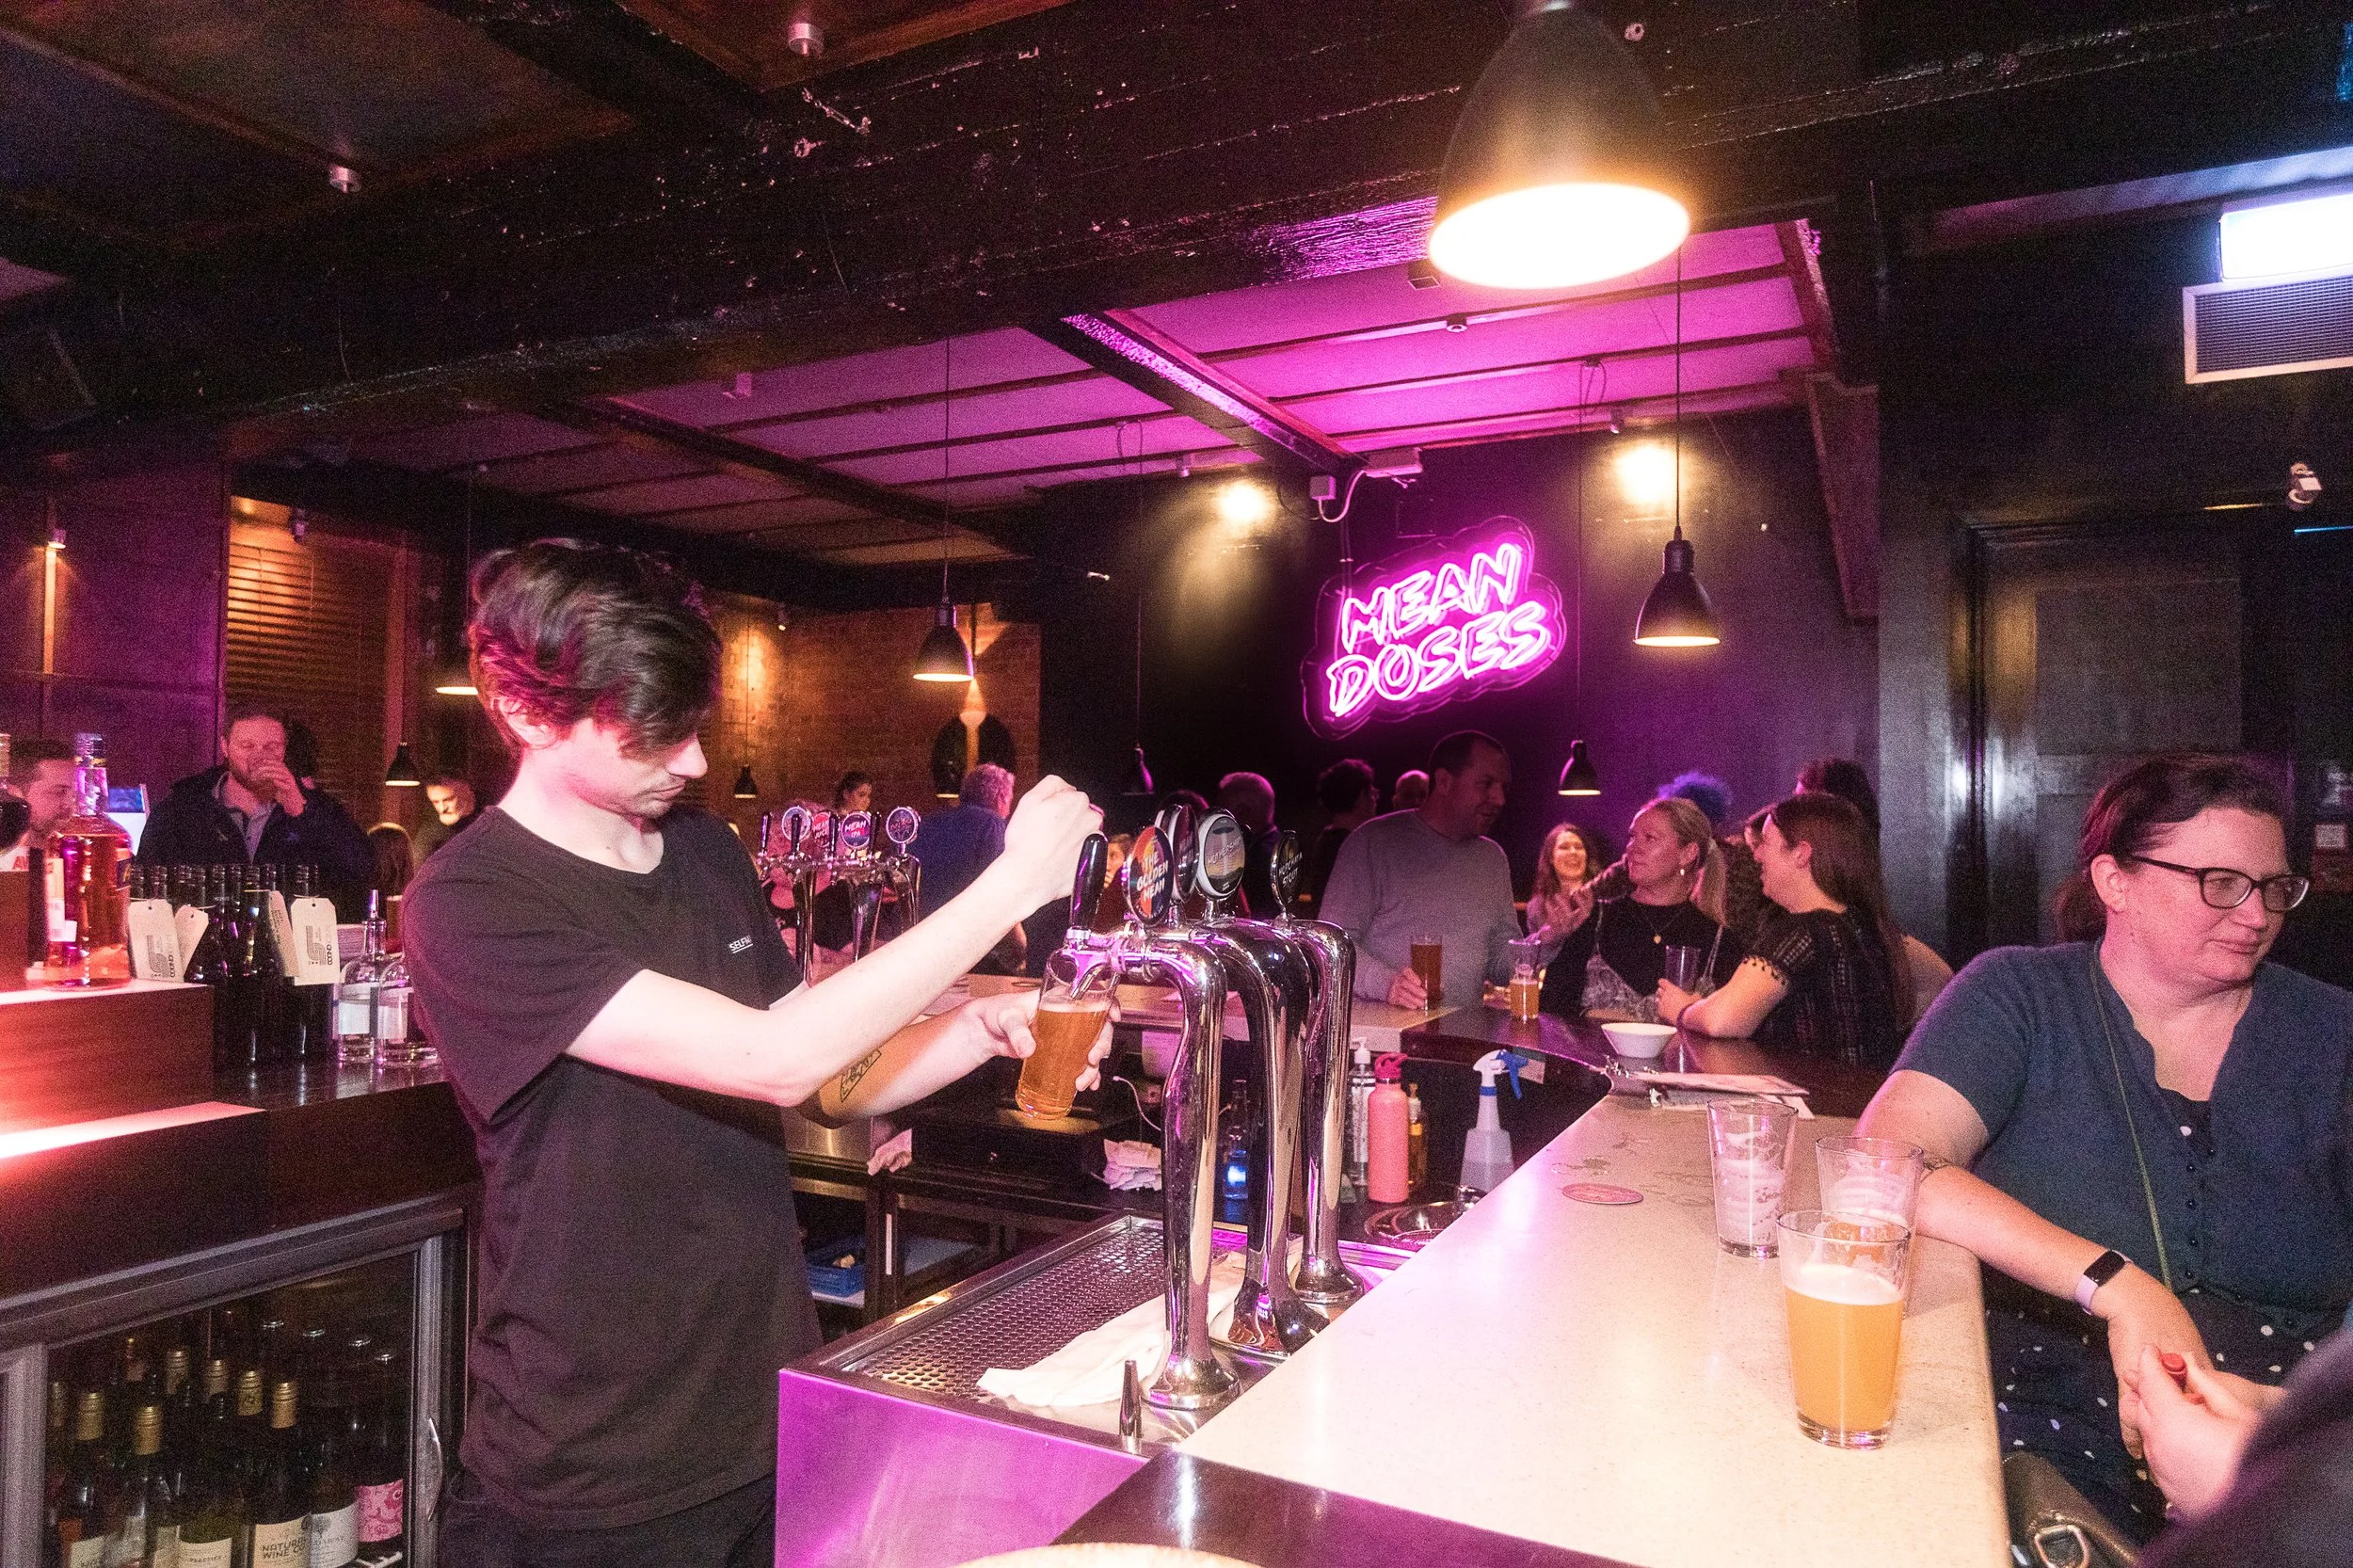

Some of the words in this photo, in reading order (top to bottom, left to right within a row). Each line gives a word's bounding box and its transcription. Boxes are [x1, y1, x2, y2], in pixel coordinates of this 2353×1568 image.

[1342, 543, 1522, 653] MEAN
[1326, 601, 1552, 717] DOSES
[845, 821, 866, 832] MEAN
[1144, 851, 1159, 871] THE
[1137, 860, 1168, 891] GOLDEN
[1144, 878, 1165, 901] MEAN
[263, 1548, 289, 1560] WINE
